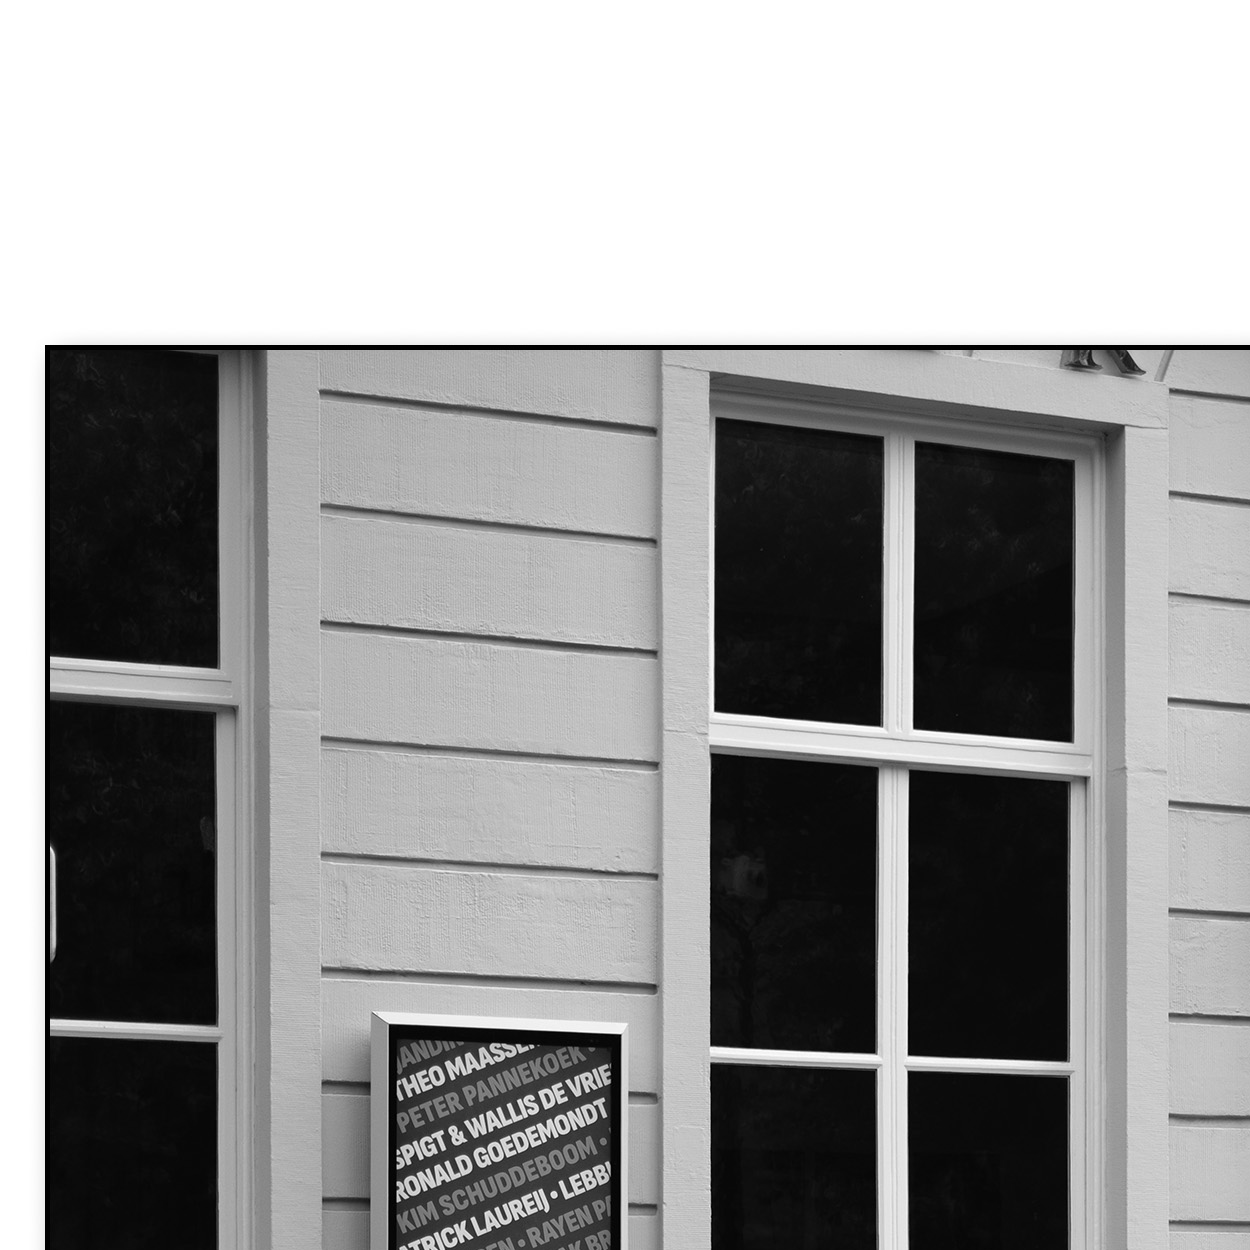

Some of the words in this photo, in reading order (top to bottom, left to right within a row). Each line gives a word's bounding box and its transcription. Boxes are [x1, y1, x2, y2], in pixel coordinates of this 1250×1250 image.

[397, 1065, 446, 1102] THEO
[397, 1092, 464, 1134] PETER
[462, 1047, 587, 1107] PANNEKOEK
[448, 1125, 468, 1146] &
[463, 1094, 540, 1139] WALLIS
[538, 1082, 568, 1110] DE
[565, 1063, 612, 1098] VRIE
[396, 1154, 473, 1203] RONALD
[473, 1097, 608, 1168] GOEDEMONDT
[397, 1200, 440, 1234] KIM
[438, 1136, 598, 1216] SCHUDDEBOOM
[470, 1188, 550, 1237] LAUREIJ
[526, 1205, 594, 1248] RAYEN
